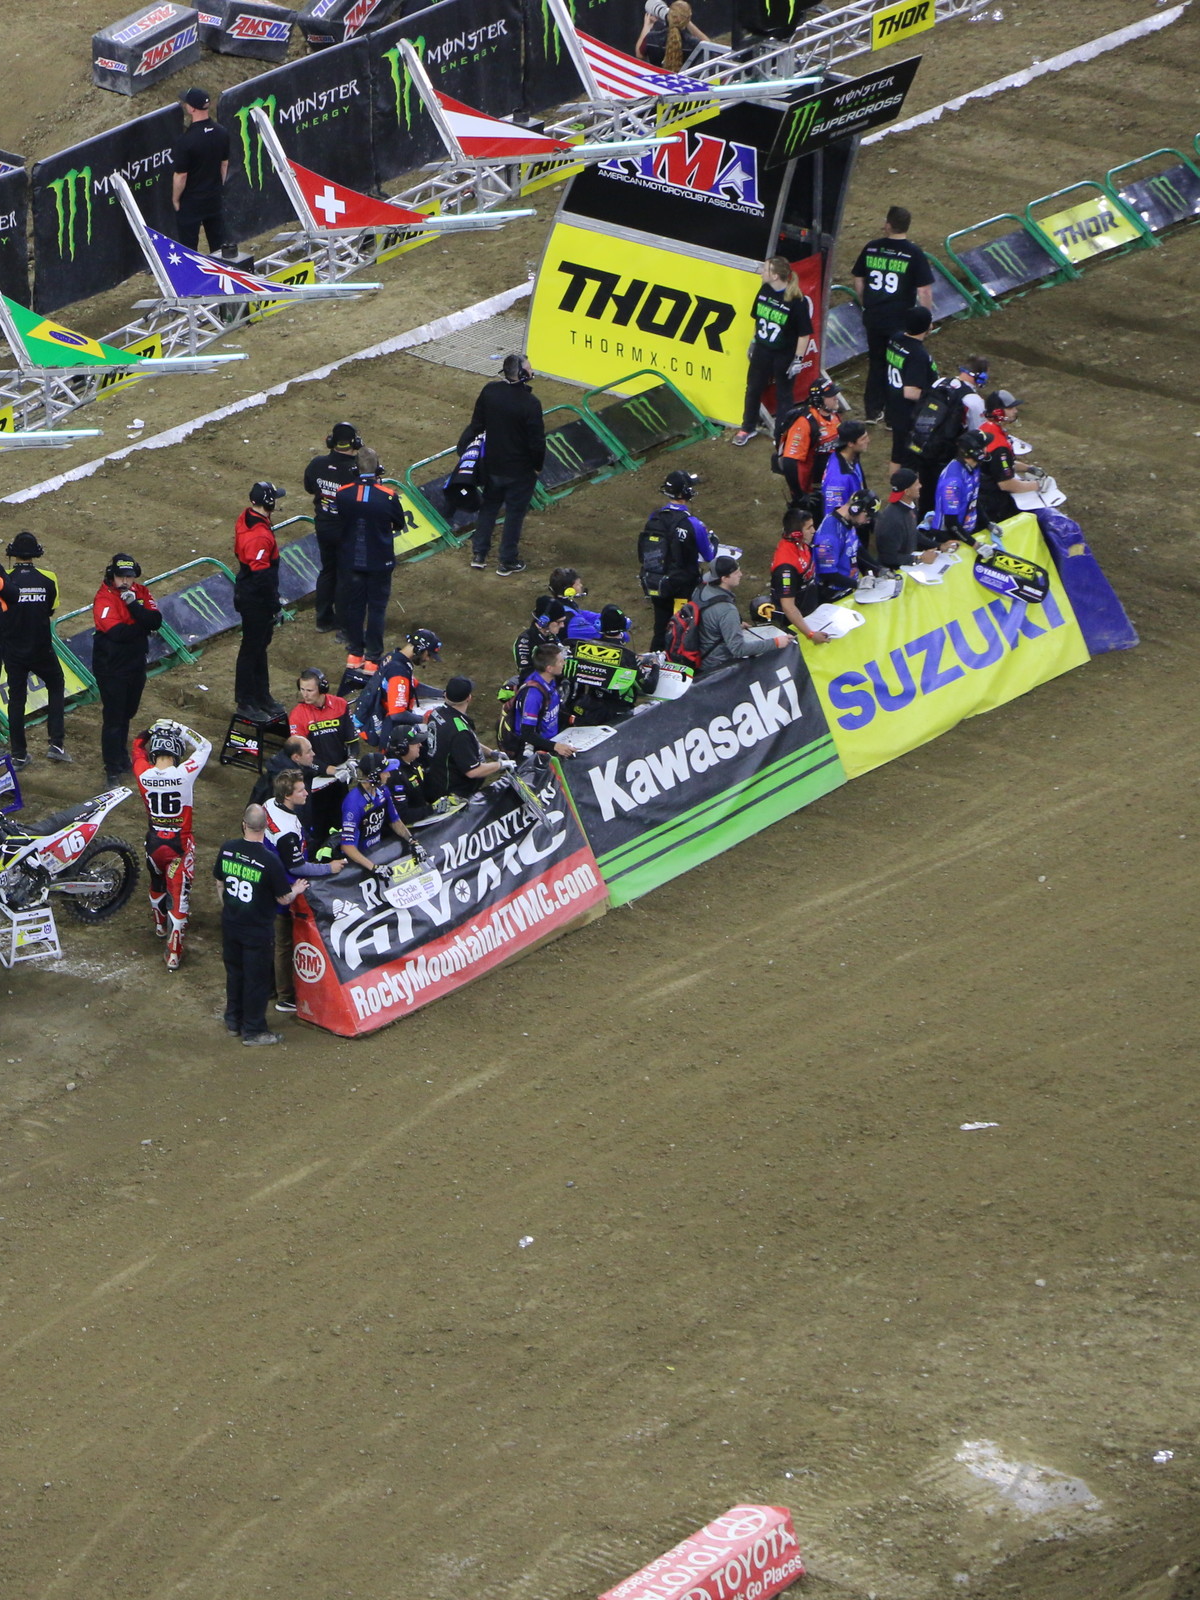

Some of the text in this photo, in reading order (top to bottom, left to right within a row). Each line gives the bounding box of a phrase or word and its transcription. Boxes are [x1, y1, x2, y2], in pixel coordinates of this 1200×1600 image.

[112, 3, 177, 44] AMSOIL
[878, 1, 929, 39] THOR
[133, 22, 198, 76] AMSOIL
[441, 45, 498, 74] ENERGY
[94, 57, 128, 72] AMSOIL
[810, 93, 903, 136] SUPERCROSS
[598, 169, 765, 218] AMERICAN MOTORCYCLIST ASSOCIATION
[1052, 210, 1120, 249] THOR
[866, 256, 909, 274] TRACK CREW
[868, 270, 899, 294] 39
[557, 260, 737, 354] THOR
[757, 319, 782, 342] 37
[570, 331, 712, 382] THORMX.COM
[984, 568, 1009, 583] YAMAHA
[828, 594, 1065, 731] SUZUKI
[308, 719, 340, 731] GEICO
[246, 739, 258, 749] 48
[588, 665, 803, 823] Kawasaki
[142, 777, 182, 788] OSBORNE
[147, 791, 182, 816] 16
[57, 830, 86, 858] 16
[222, 859, 262, 883] TRACK CREW
[225, 875, 253, 903] 38
[350, 862, 599, 1020] RockyMountainATVMC.com
[648, 1559, 671, 1572] Go
[711, 1523, 797, 1599] TOYOTA
[612, 1571, 657, 1599] Places
[746, 1555, 804, 1600] Go Places
